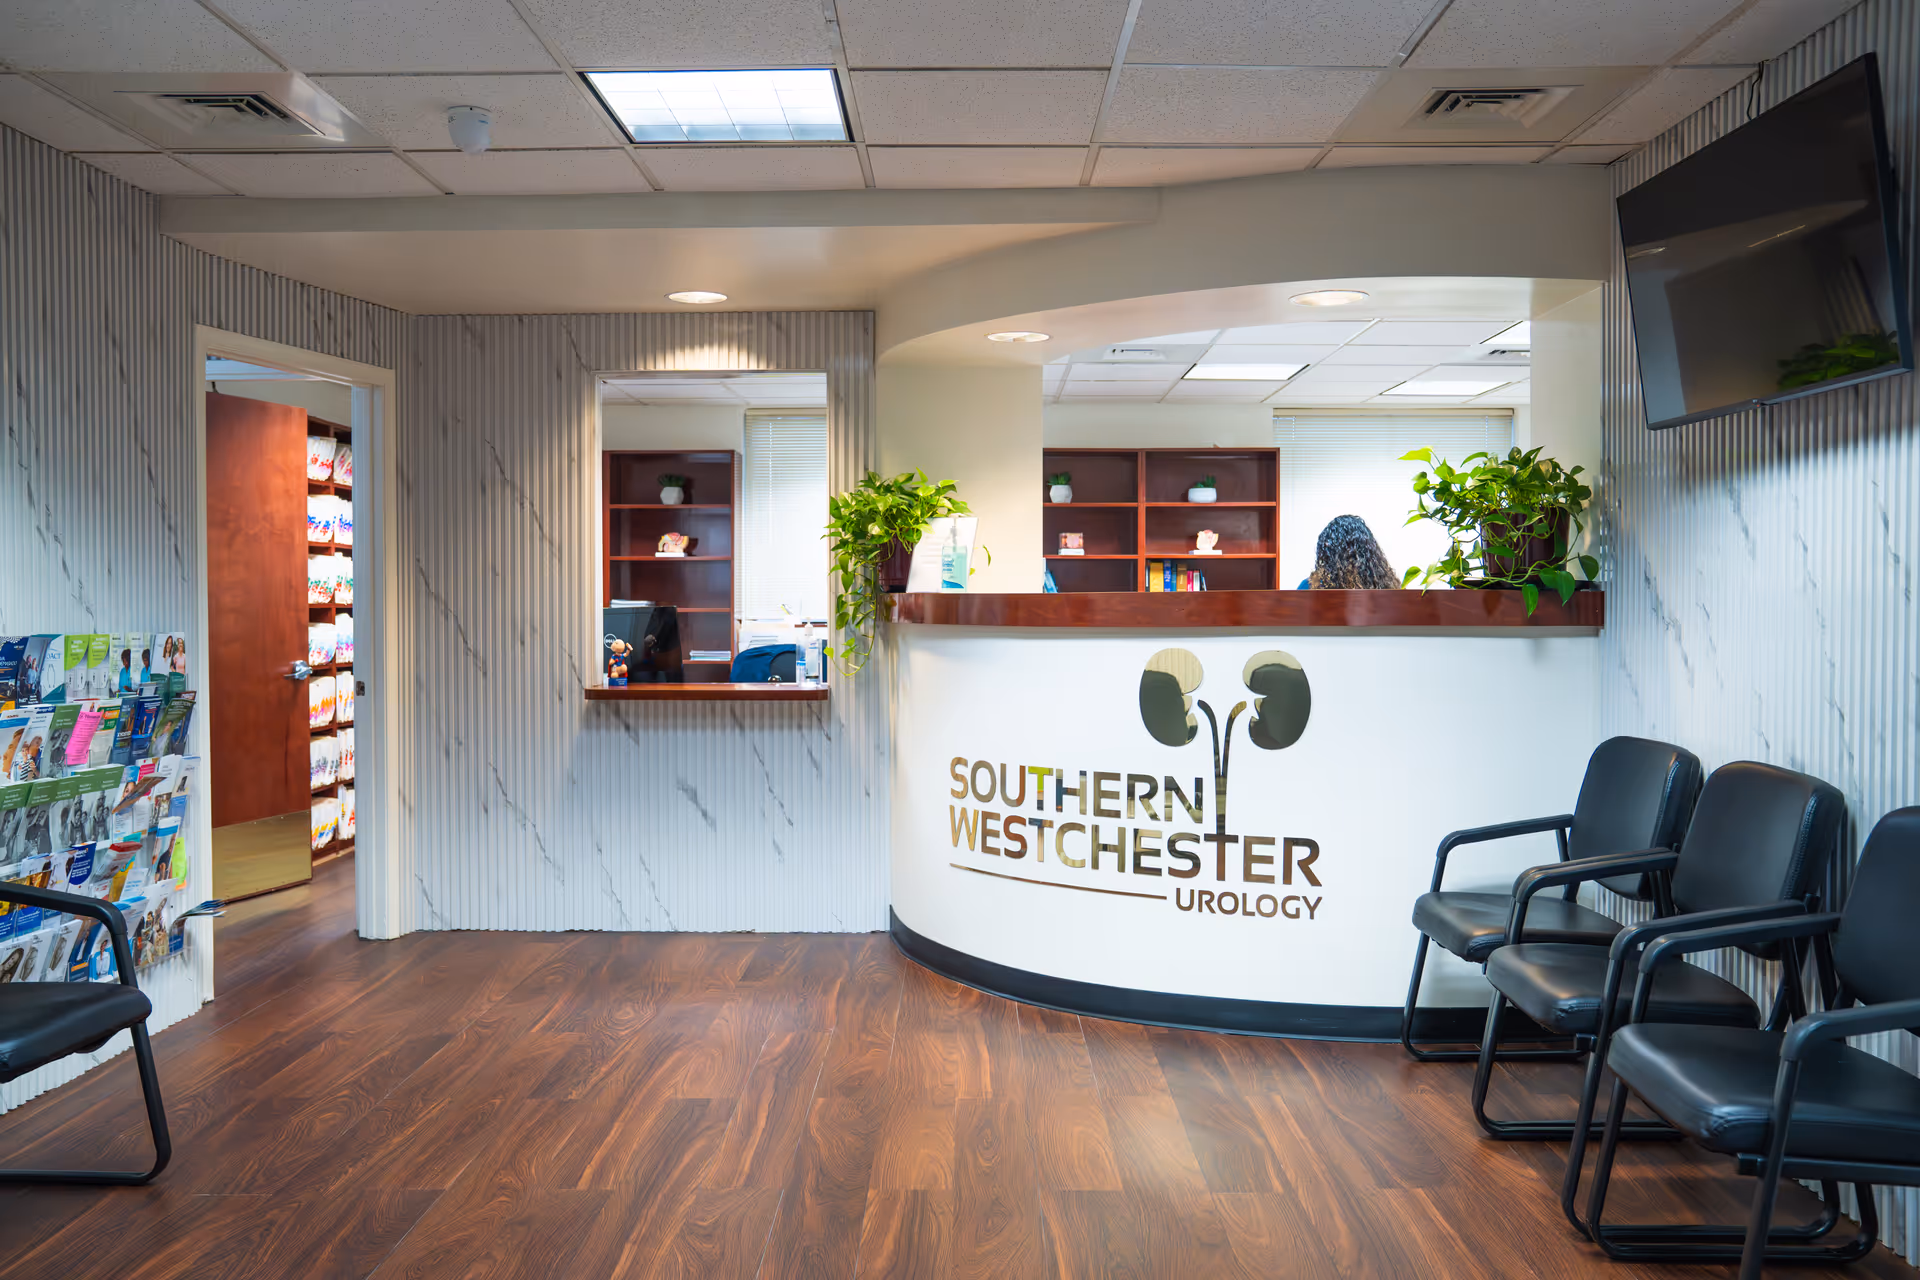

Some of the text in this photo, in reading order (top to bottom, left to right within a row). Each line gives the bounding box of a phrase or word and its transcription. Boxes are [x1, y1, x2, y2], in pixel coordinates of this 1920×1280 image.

[950, 756, 1203, 824] SOUTHERN
[949, 804, 1322, 887] WESTCHESTER
[1175, 887, 1323, 920] UROLOGY
